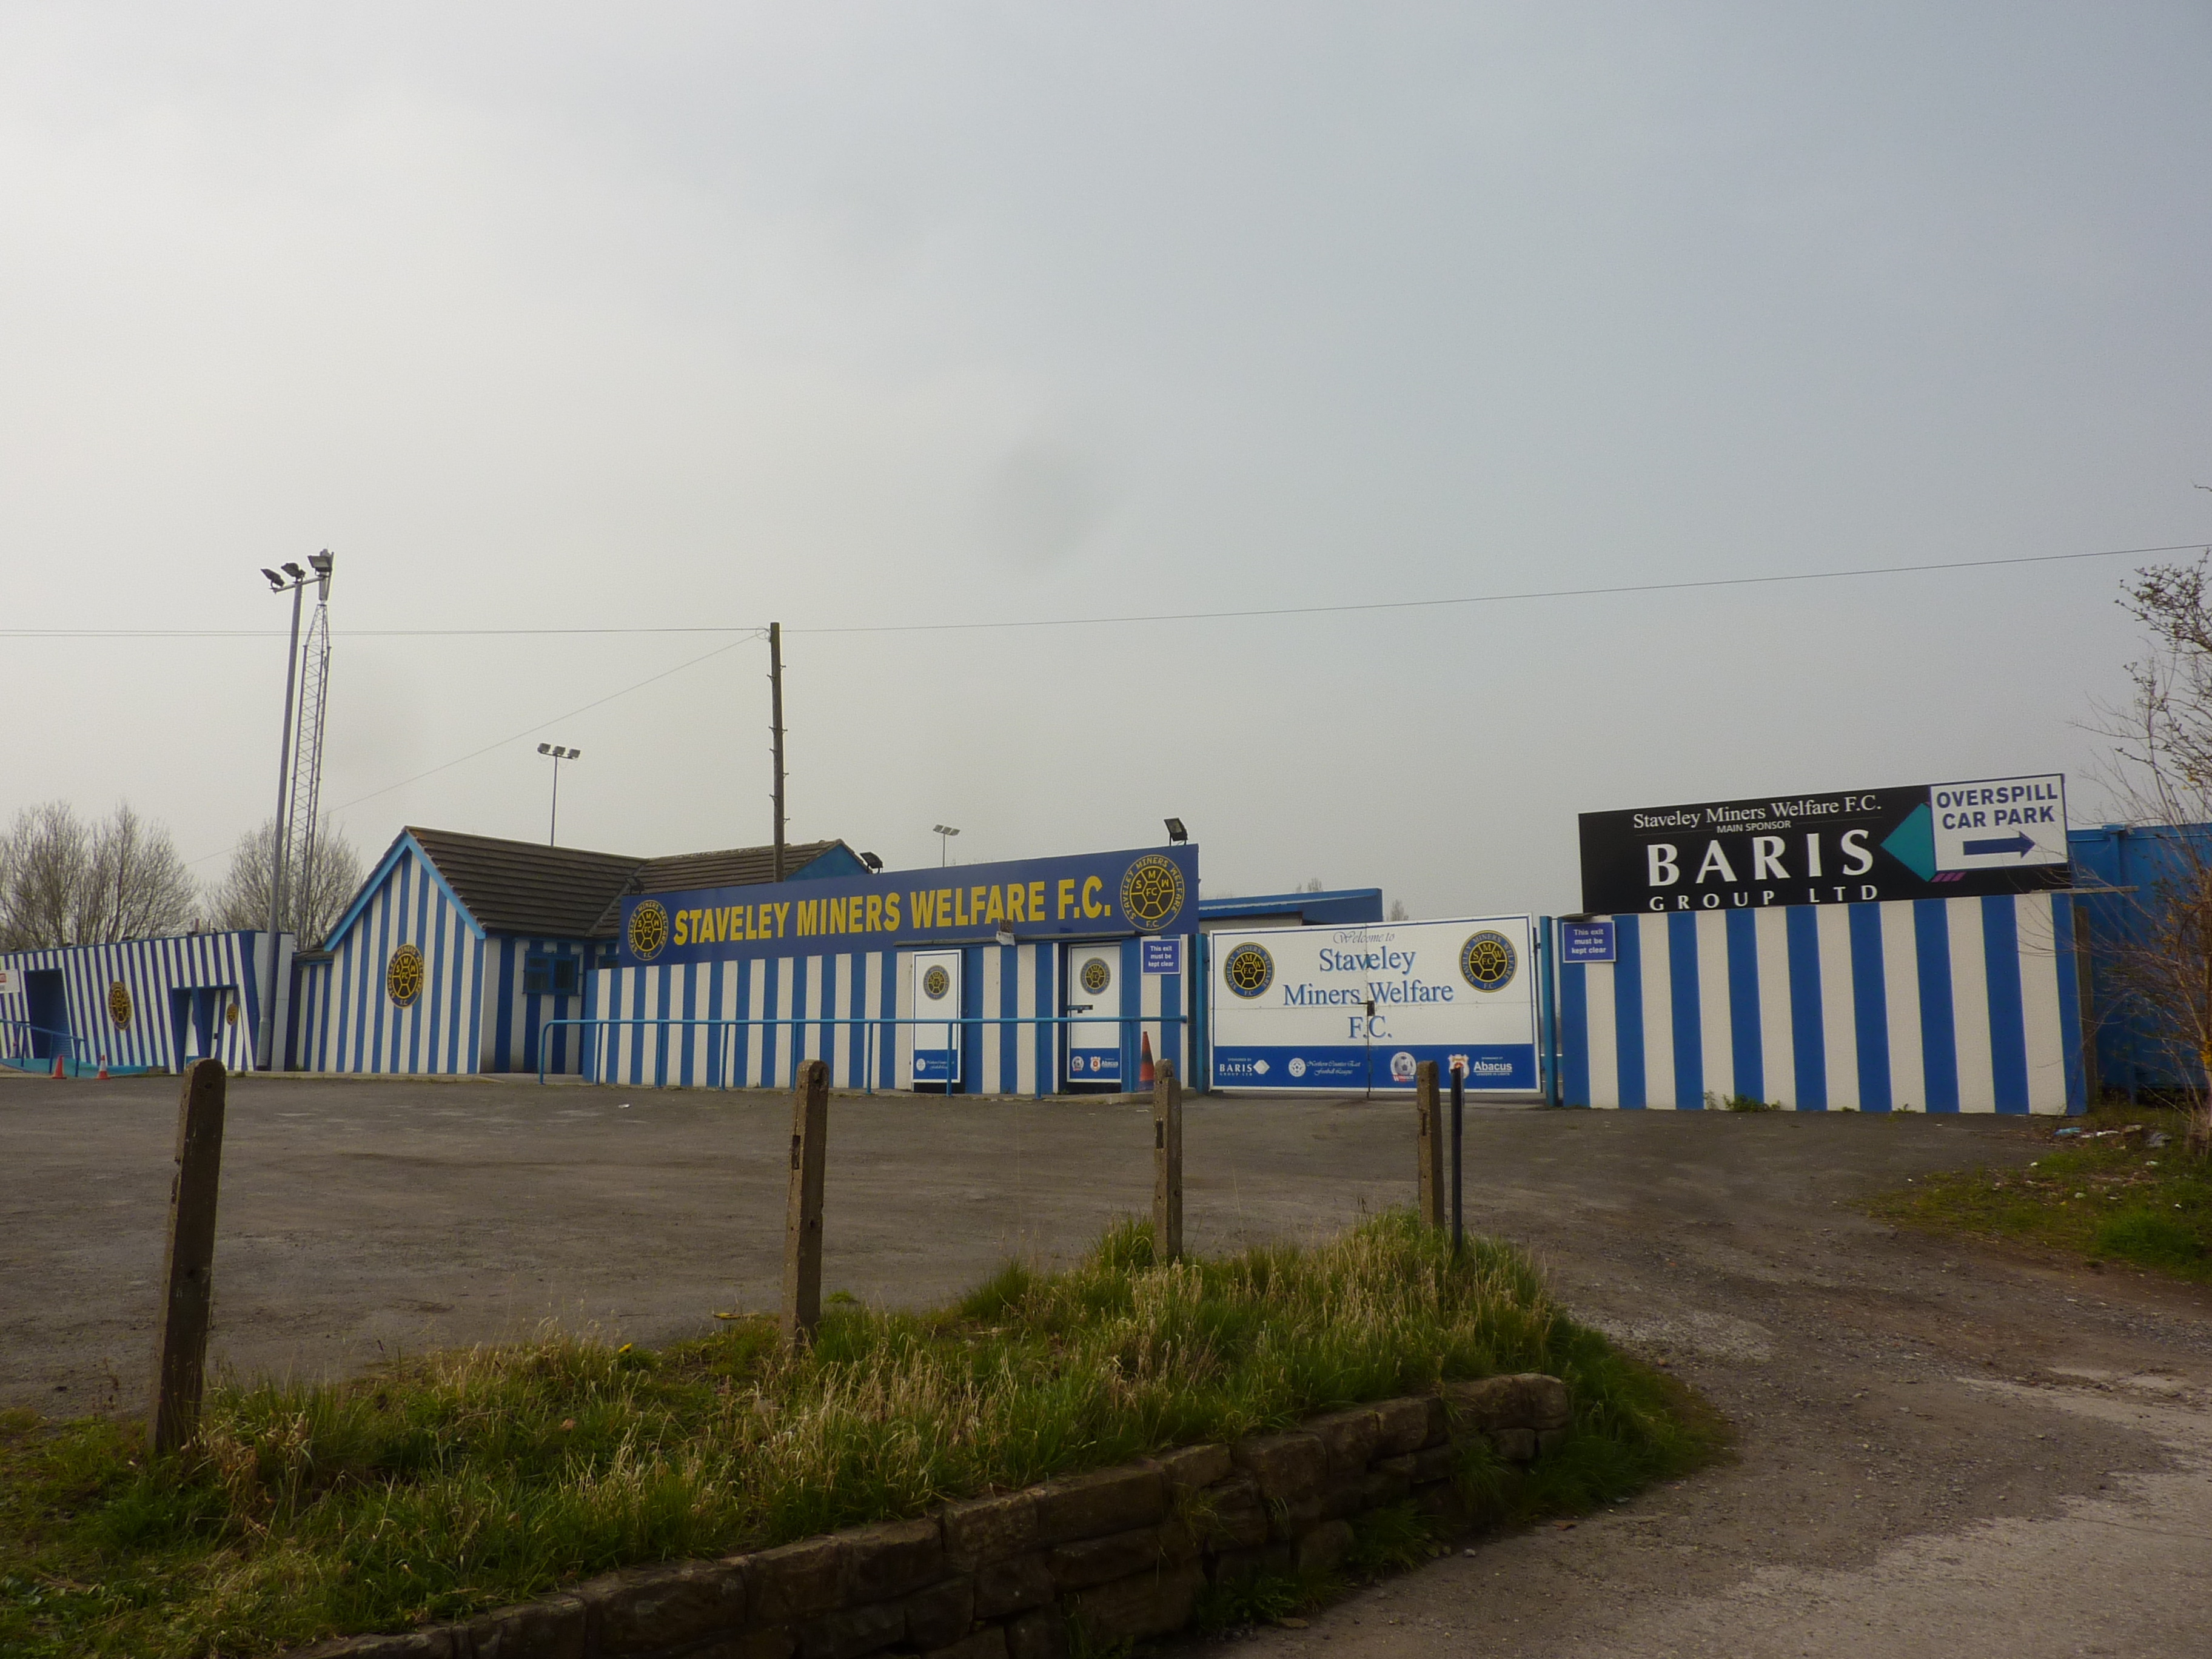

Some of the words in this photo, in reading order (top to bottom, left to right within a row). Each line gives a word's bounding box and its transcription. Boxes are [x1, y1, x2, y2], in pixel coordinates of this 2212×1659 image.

[1937, 783, 2057, 808] OVERSPILL
[1634, 810, 1701, 828] Staveley
[1706, 806, 1766, 823] Miners
[1771, 799, 1839, 817] Welfare
[1844, 795, 1882, 812] F.C.
[1942, 811, 1986, 830] CAR
[1994, 805, 2055, 826] PARK
[1717, 824, 1743, 833] MAIN
[1746, 820, 1791, 831] SPONSOR
[1647, 829, 1874, 886] BARIS
[1123, 870, 1136, 920] STAVELEY
[1136, 857, 1168, 870] MINERS
[1170, 867, 1183, 914] WELFARE
[1649, 890, 1775, 911] GROUP
[1809, 885, 1878, 903] LTD
[674, 902, 790, 945] STAVELEY
[797, 892, 900, 936] MINERS
[910, 881, 1045, 929] WELFARE
[1058, 875, 1111, 920] F.C.
[1236, 945, 1261, 954] MINERS
[1333, 931, 1384, 943] Welcome
[1386, 933, 1395, 941] to
[1473, 934, 1502, 943] MINERS
[1319, 945, 1416, 976] Staveley
[1282, 983, 1361, 1005] Miners
[1367, 979, 1453, 1003] Welfare
[1347, 1015, 1392, 1039] F.C.
[1219, 1064, 1252, 1072] BARIS
[1473, 1061, 1512, 1071] Abacus
